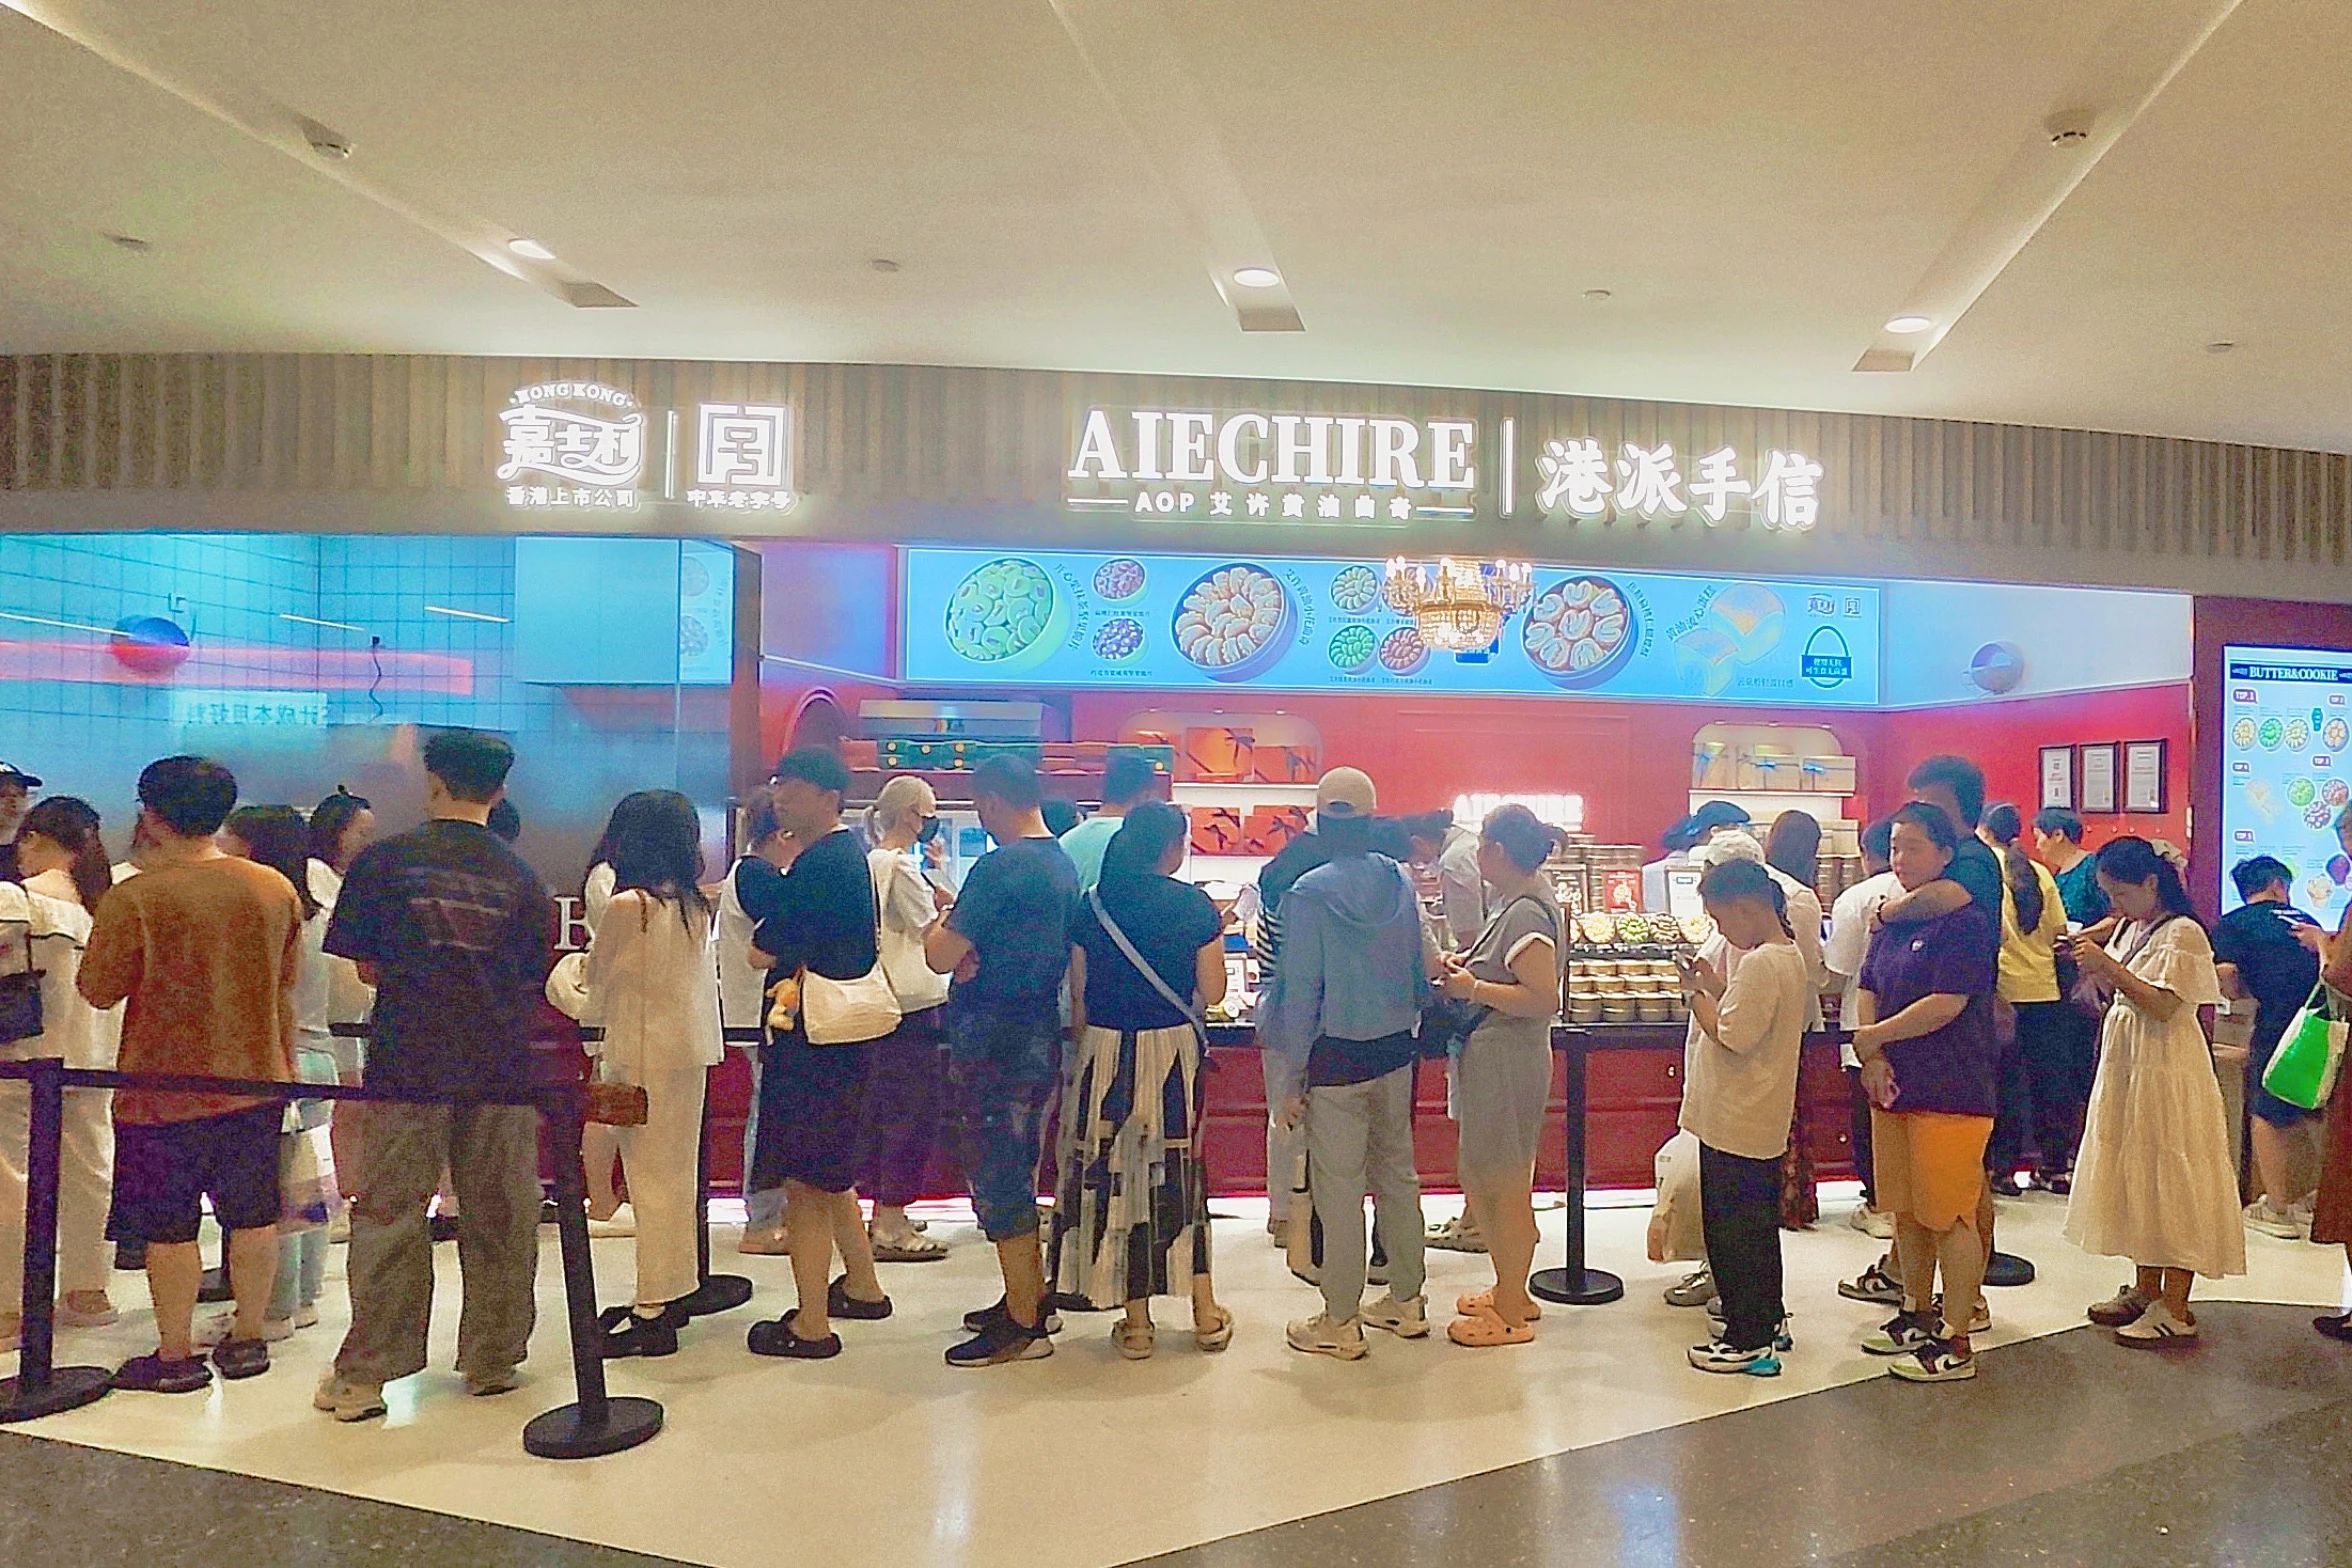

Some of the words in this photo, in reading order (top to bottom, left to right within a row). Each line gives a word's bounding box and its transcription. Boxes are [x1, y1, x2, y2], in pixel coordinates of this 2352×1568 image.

[573, 384, 627, 406] KONG
[1068, 411, 1474, 489] AIECHIRE
[1539, 439, 1824, 528] 港派手信
[1135, 492, 1196, 513] AOP
[2249, 666, 2338, 681] BUTTER&COOKIE
